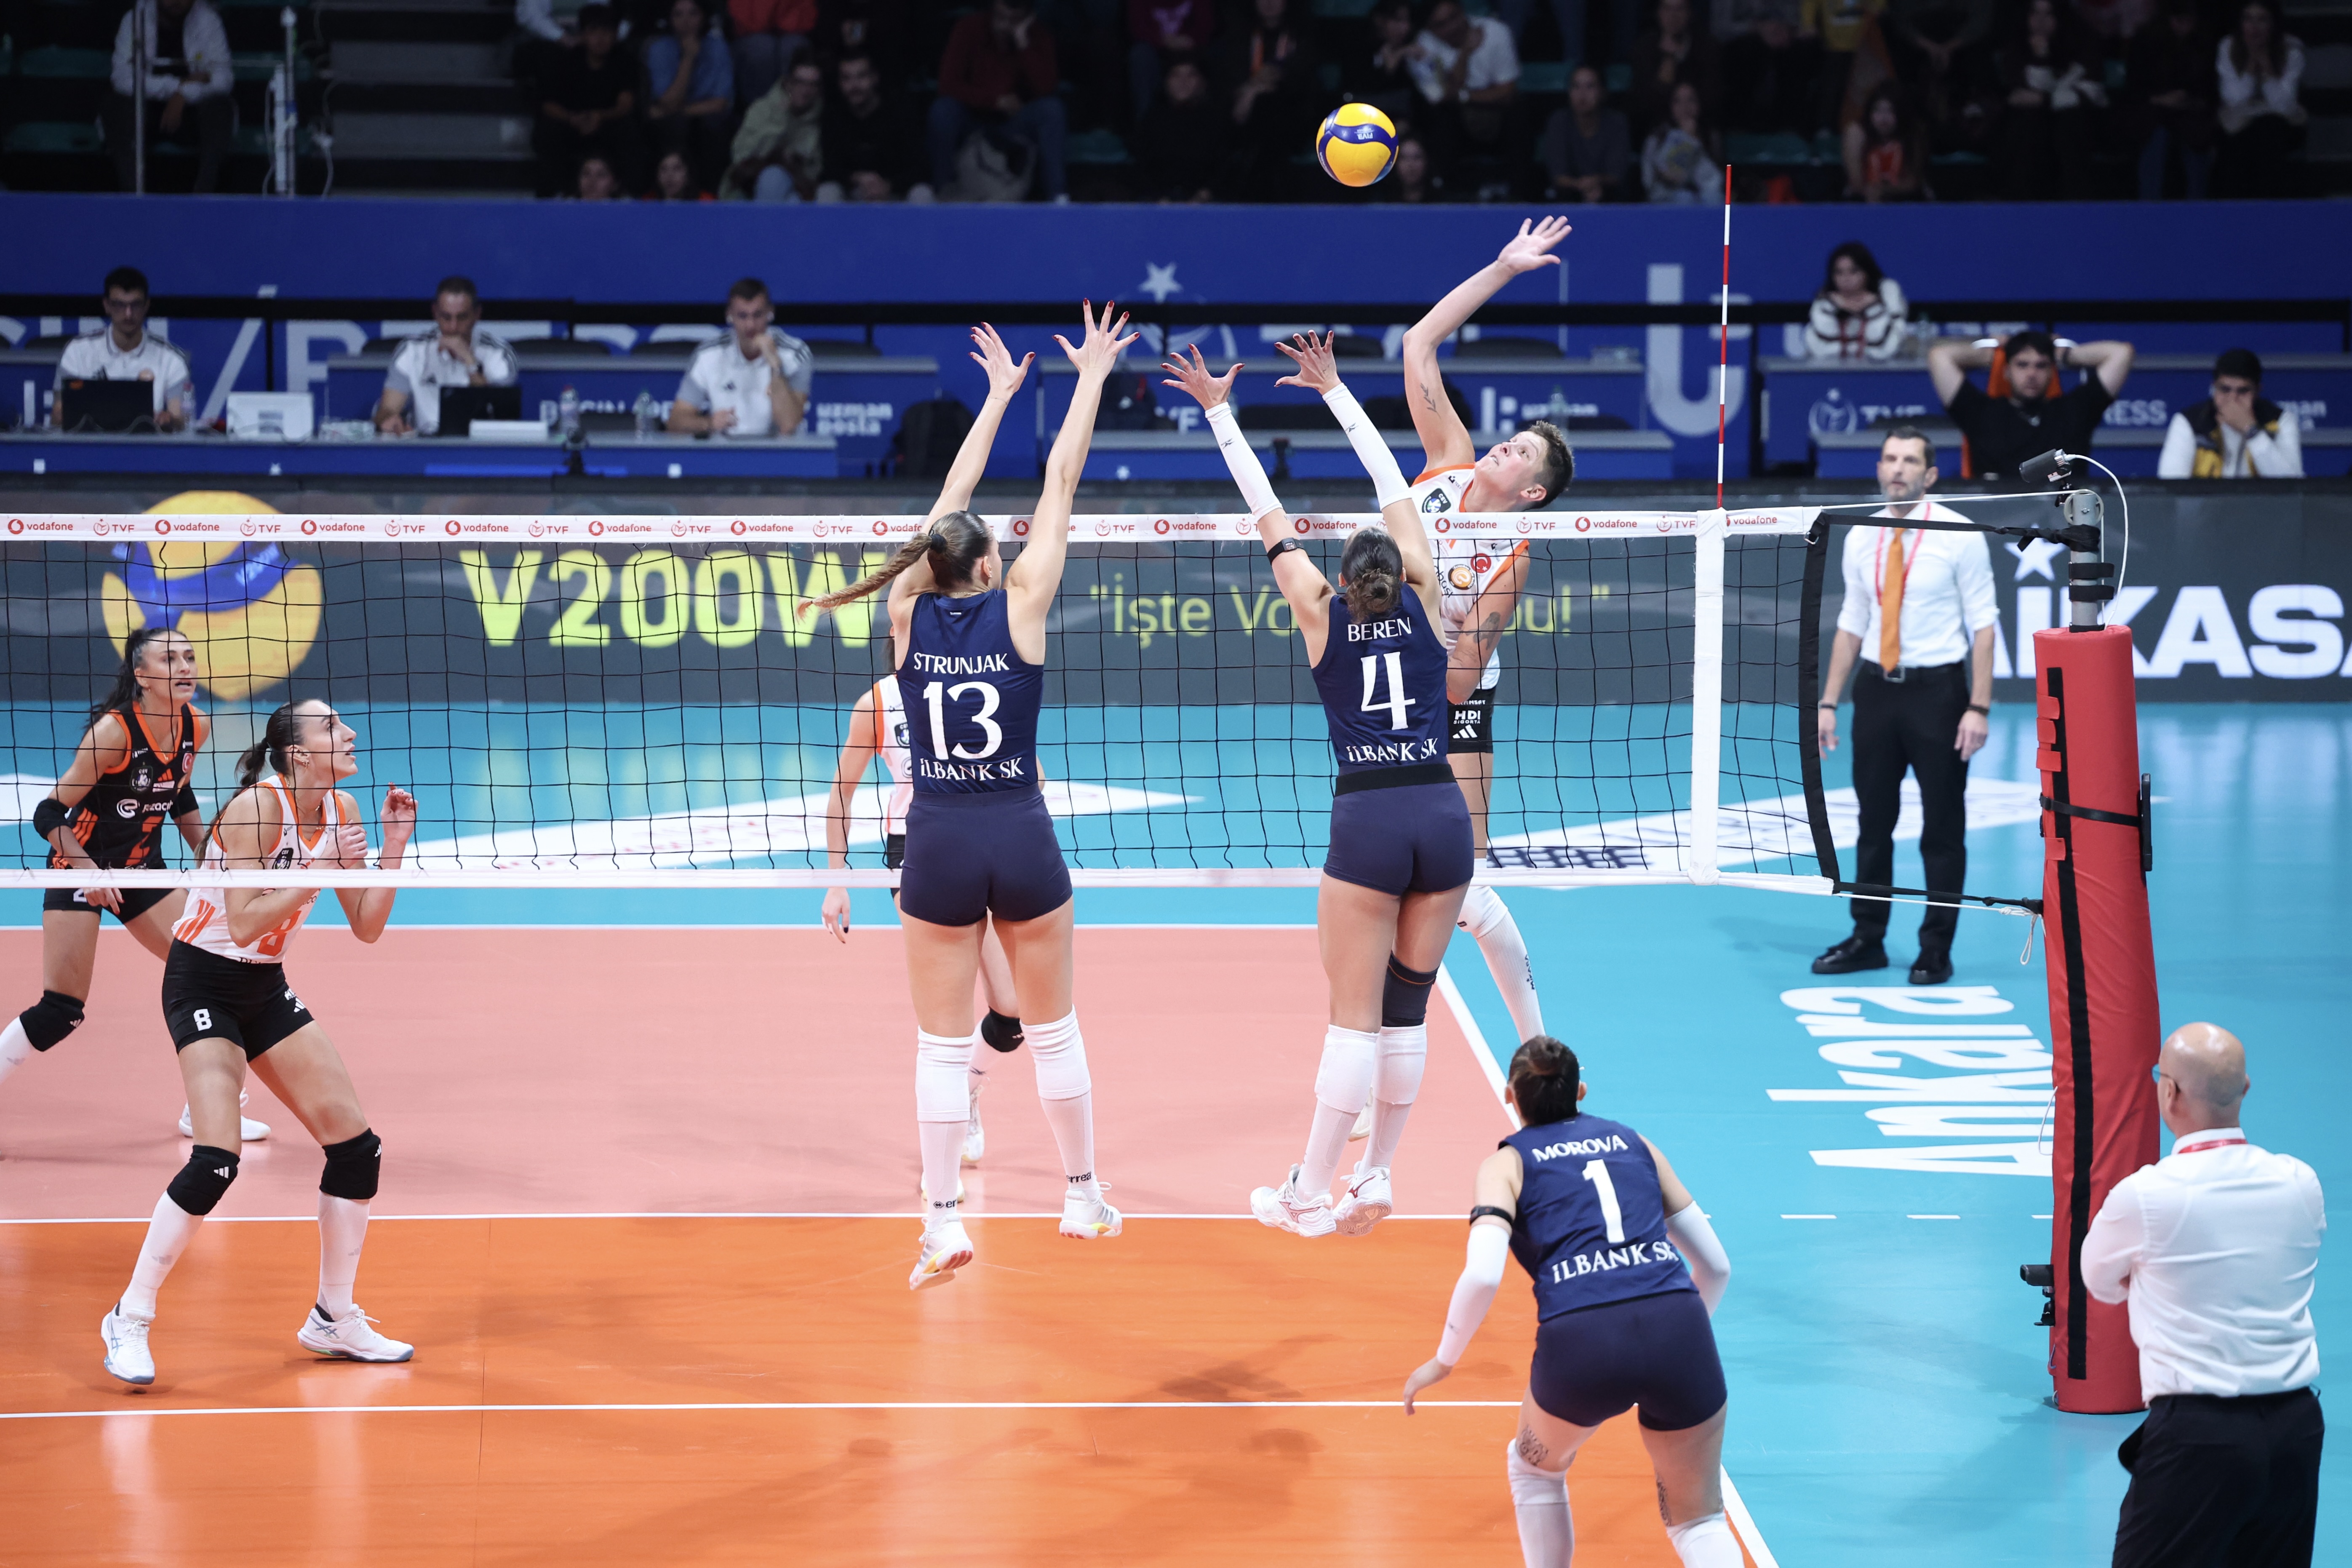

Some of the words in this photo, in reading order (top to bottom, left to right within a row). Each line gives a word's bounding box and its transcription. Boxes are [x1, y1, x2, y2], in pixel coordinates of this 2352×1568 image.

[1438, 493, 1448, 504] CEV
[27, 522, 73, 531] vodafone
[112, 524, 135, 532] TVF
[174, 523, 220, 532] vodafone
[259, 525, 281, 533] TVF
[320, 523, 365, 532] vodafone
[464, 524, 509, 532] vodafone
[607, 524, 652, 532] vodafone
[748, 523, 794, 532] vodafone
[890, 523, 922, 532] vodafo
[1113, 525, 1135, 533] TVF
[1172, 522, 1217, 531] vodafone
[1313, 521, 1357, 530] vodafone
[1452, 521, 1497, 529] vodafone
[1534, 522, 1556, 530] TVF
[1593, 520, 1637, 528] vodafone
[1674, 521, 1695, 529] TVF
[1733, 516, 1777, 525] vodafone
[459, 549, 887, 648] V200W
[1348, 617, 1412, 642] BEREN
[913, 652, 1009, 675] STRUNJAK
[1360, 651, 1416, 730] 4
[923, 681, 1003, 760] 13
[1454, 710, 1481, 720] HDI
[1420, 738, 1438, 759] SK
[1000, 757, 1024, 779] SK
[193, 1008, 212, 1031] 8
[1765, 986, 2054, 1177] Ankara
[1531, 1134, 1629, 1162] MOROVA
[1582, 1159, 1626, 1244] 1
[1652, 1241, 1679, 1262] SK
